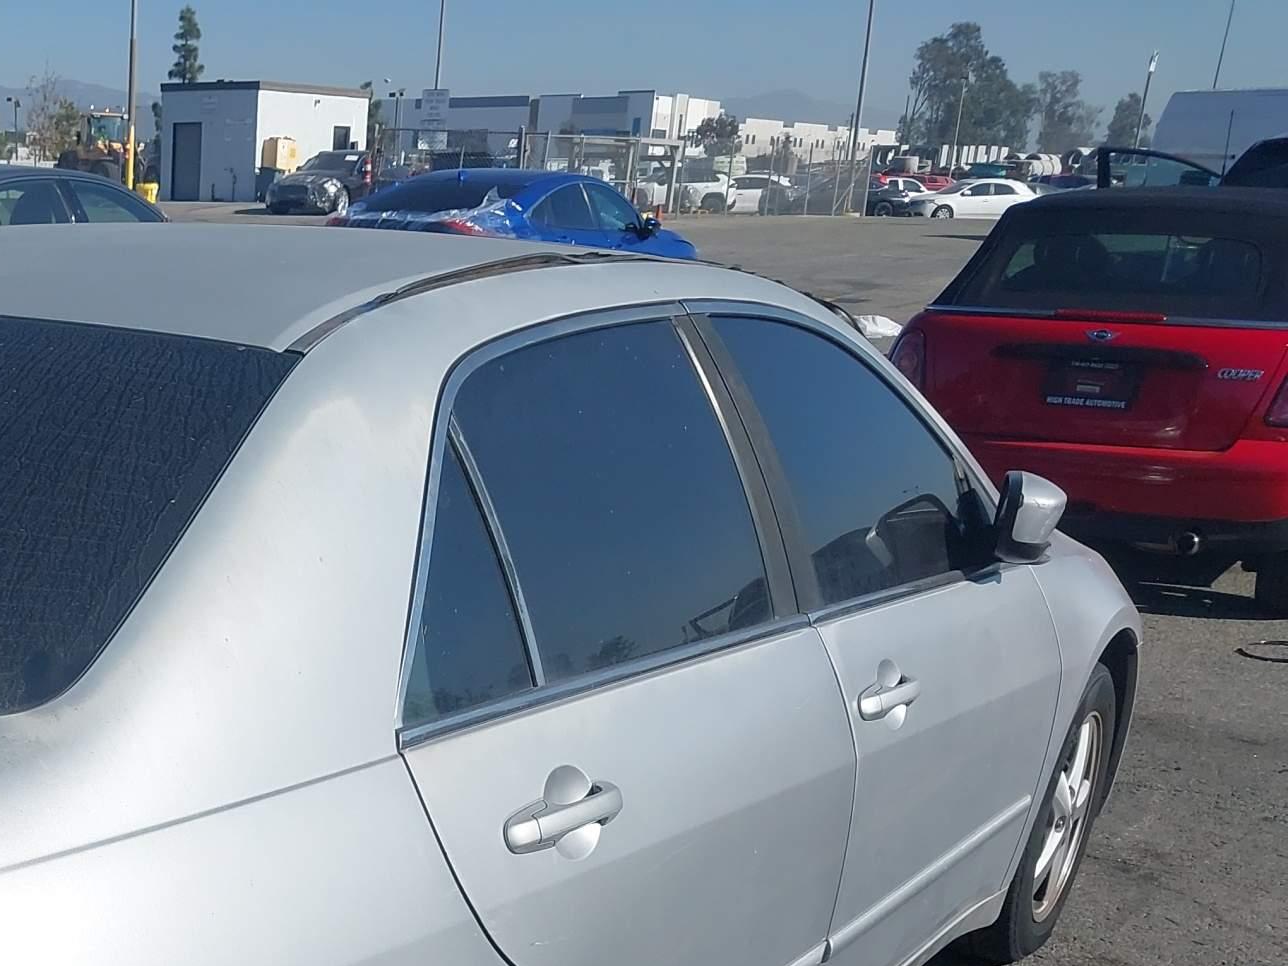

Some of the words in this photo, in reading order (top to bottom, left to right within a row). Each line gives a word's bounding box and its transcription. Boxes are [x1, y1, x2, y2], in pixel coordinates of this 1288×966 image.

[1218, 368, 1264, 381] COOPER
[1064, 397, 1085, 406] TRADE
[1085, 399, 1126, 409] AUTOMOTIVE
